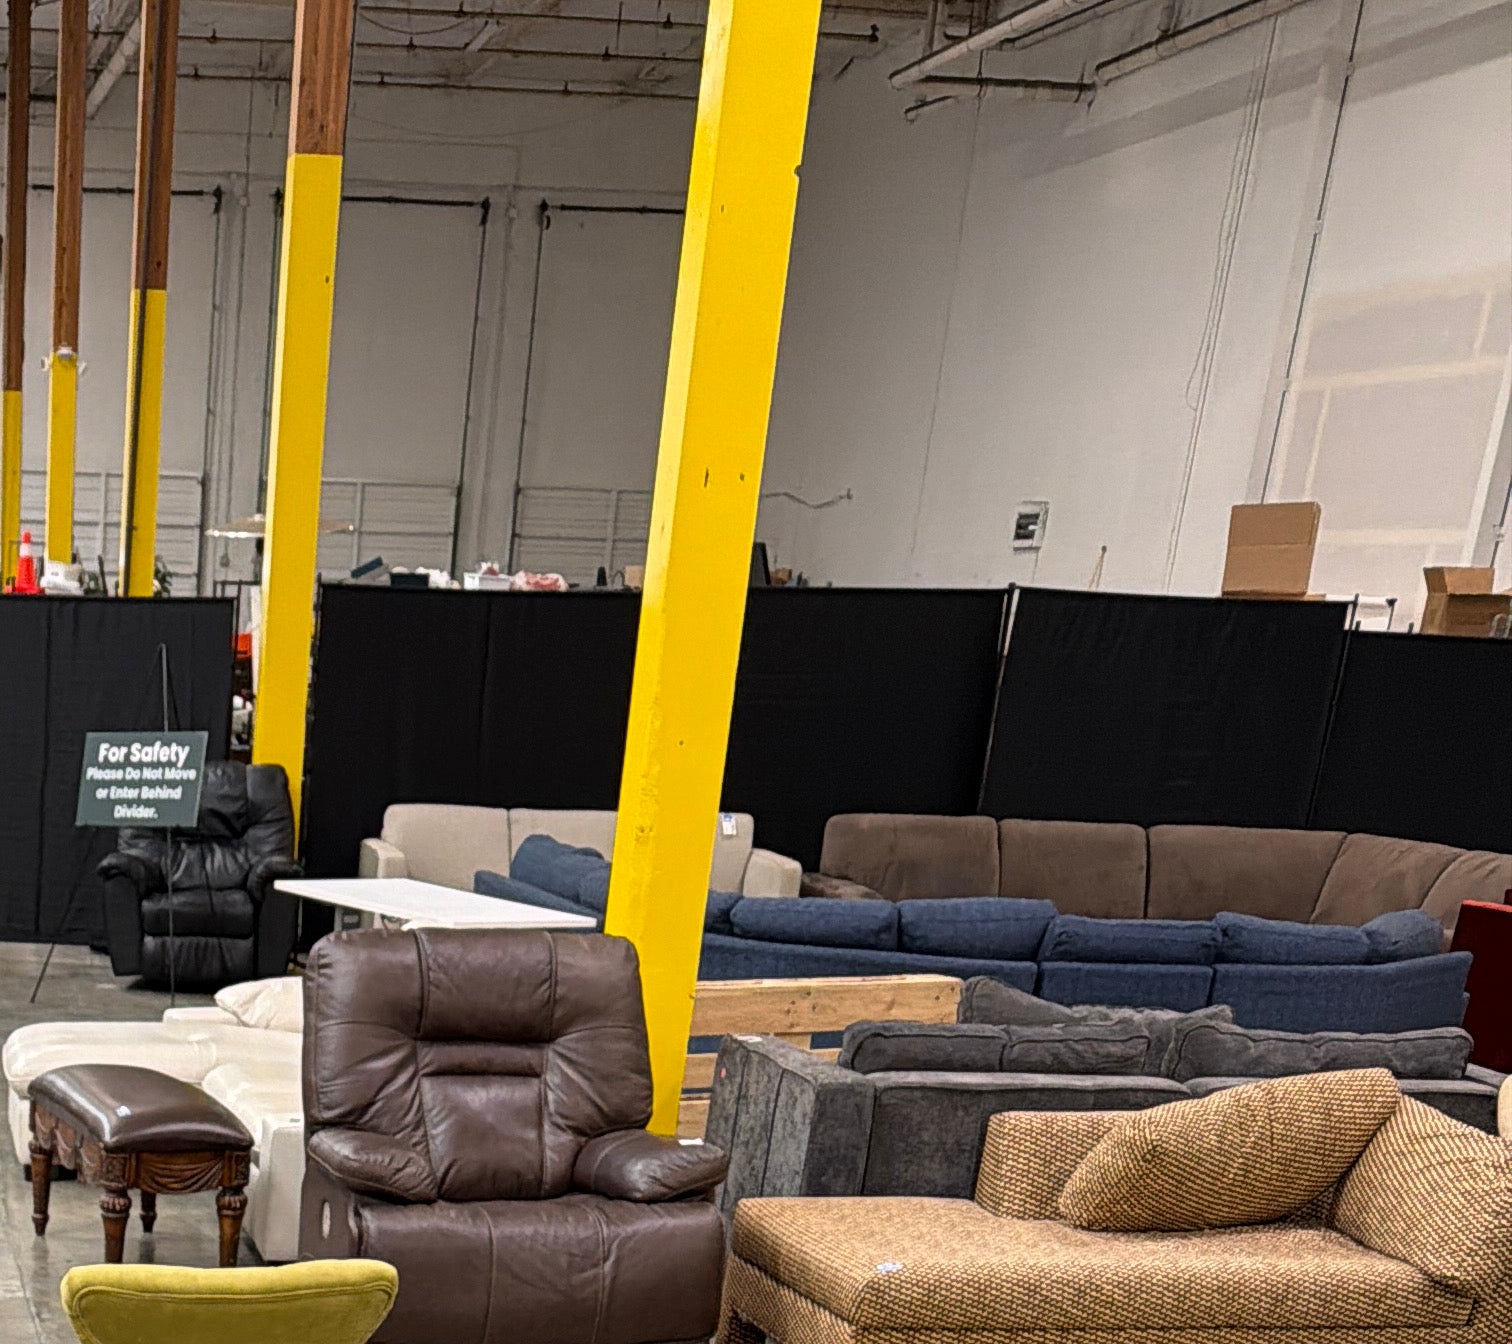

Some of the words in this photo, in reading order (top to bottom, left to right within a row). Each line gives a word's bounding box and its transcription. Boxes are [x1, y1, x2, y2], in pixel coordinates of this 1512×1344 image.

[98, 742, 128, 763] For
[129, 740, 190, 768] Safety
[86, 766, 123, 780] Please
[125, 767, 141, 780] Do
[142, 767, 163, 780] Not
[164, 767, 197, 780] Move
[95, 787, 109, 799] or
[109, 786, 140, 799] Enter
[141, 784, 183, 800] Behind
[113, 803, 159, 819] Divider.
